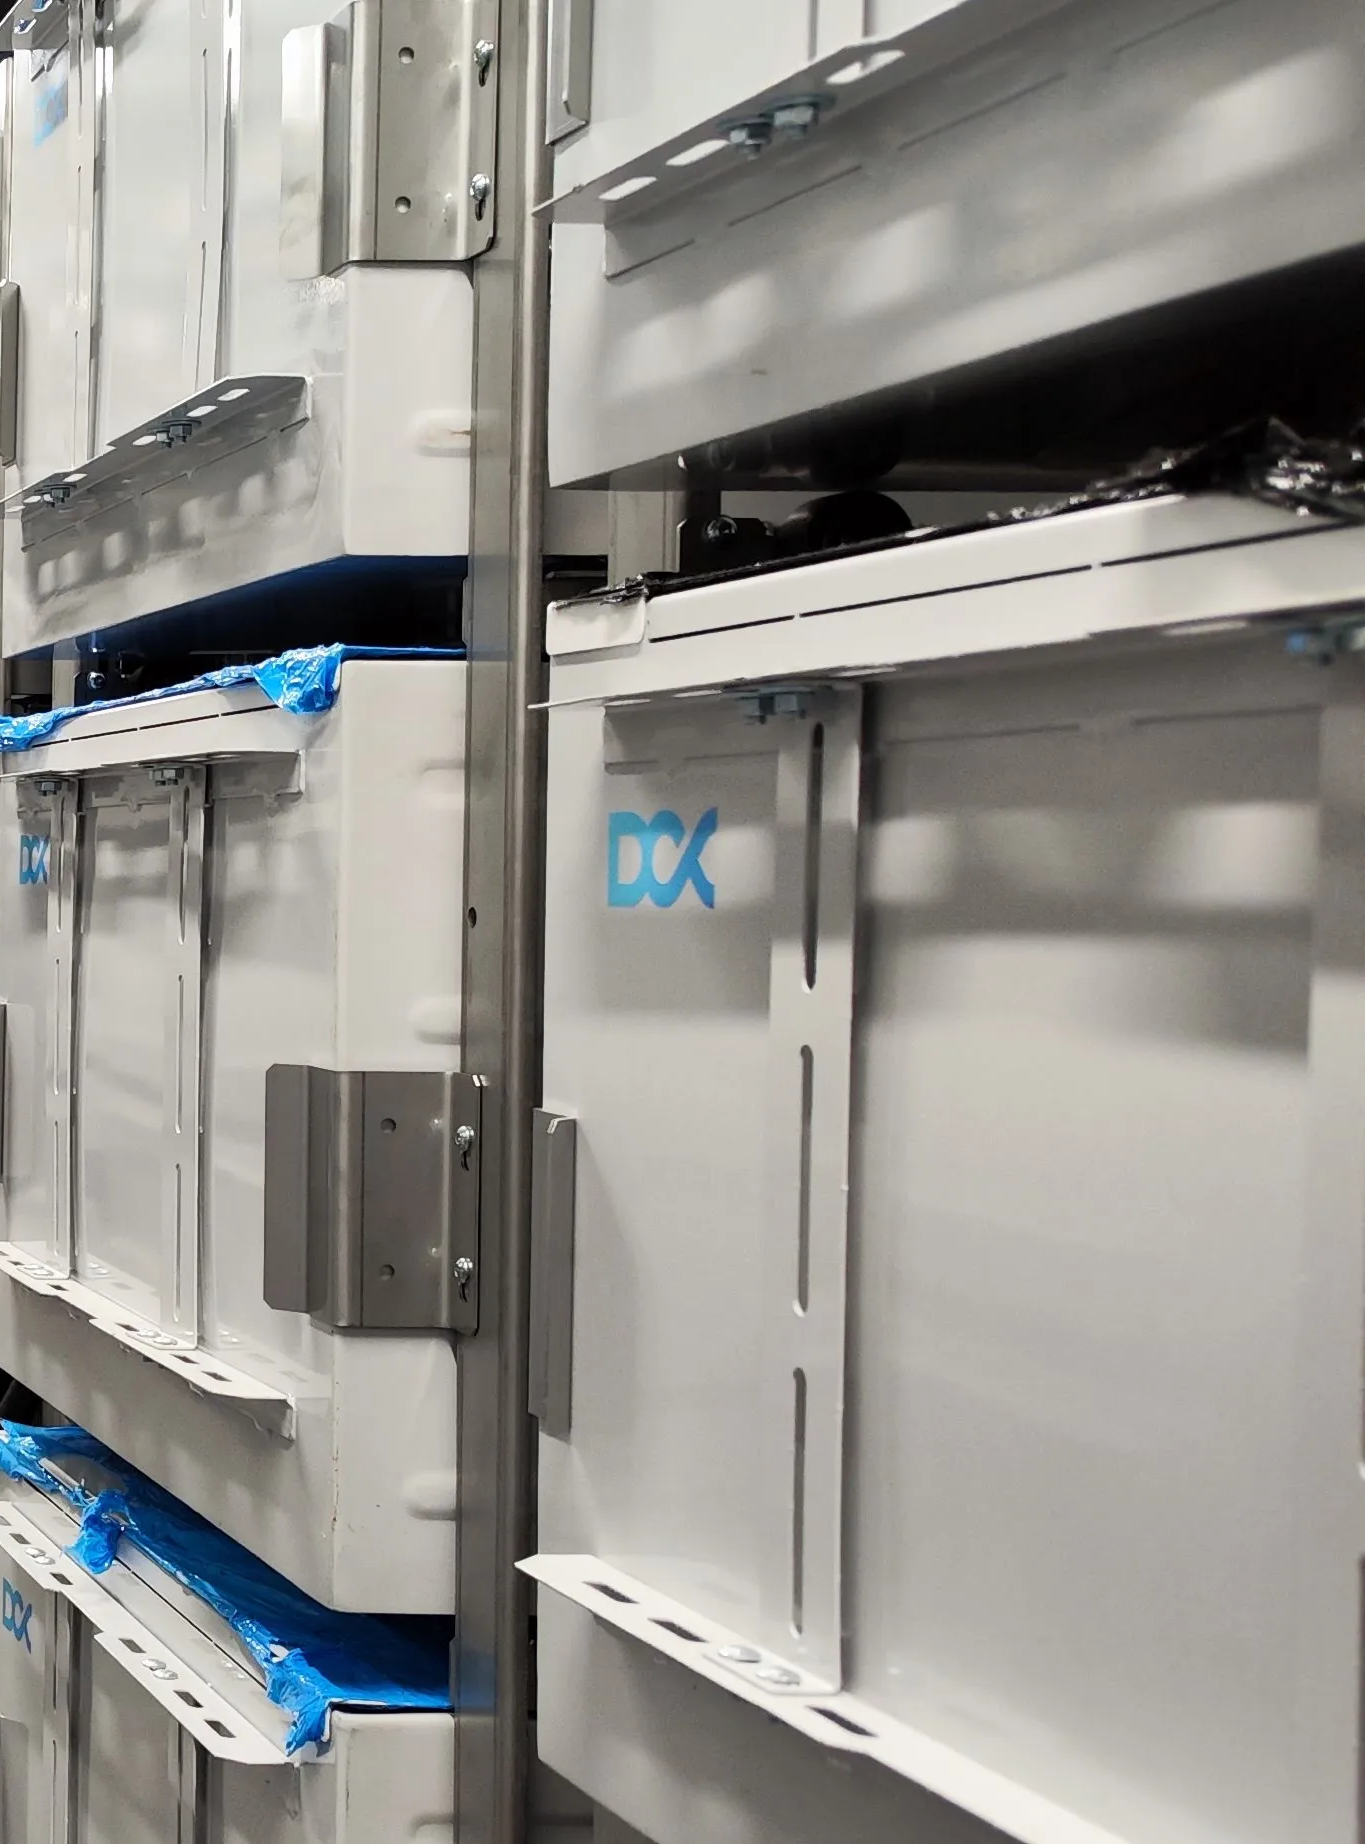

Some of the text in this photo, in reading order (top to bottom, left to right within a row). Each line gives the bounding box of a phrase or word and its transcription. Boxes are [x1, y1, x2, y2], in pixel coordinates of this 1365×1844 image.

[19, 834, 50, 885] DCX
[608, 807, 718, 910] DCX
[2, 1577, 32, 1655] DCX
